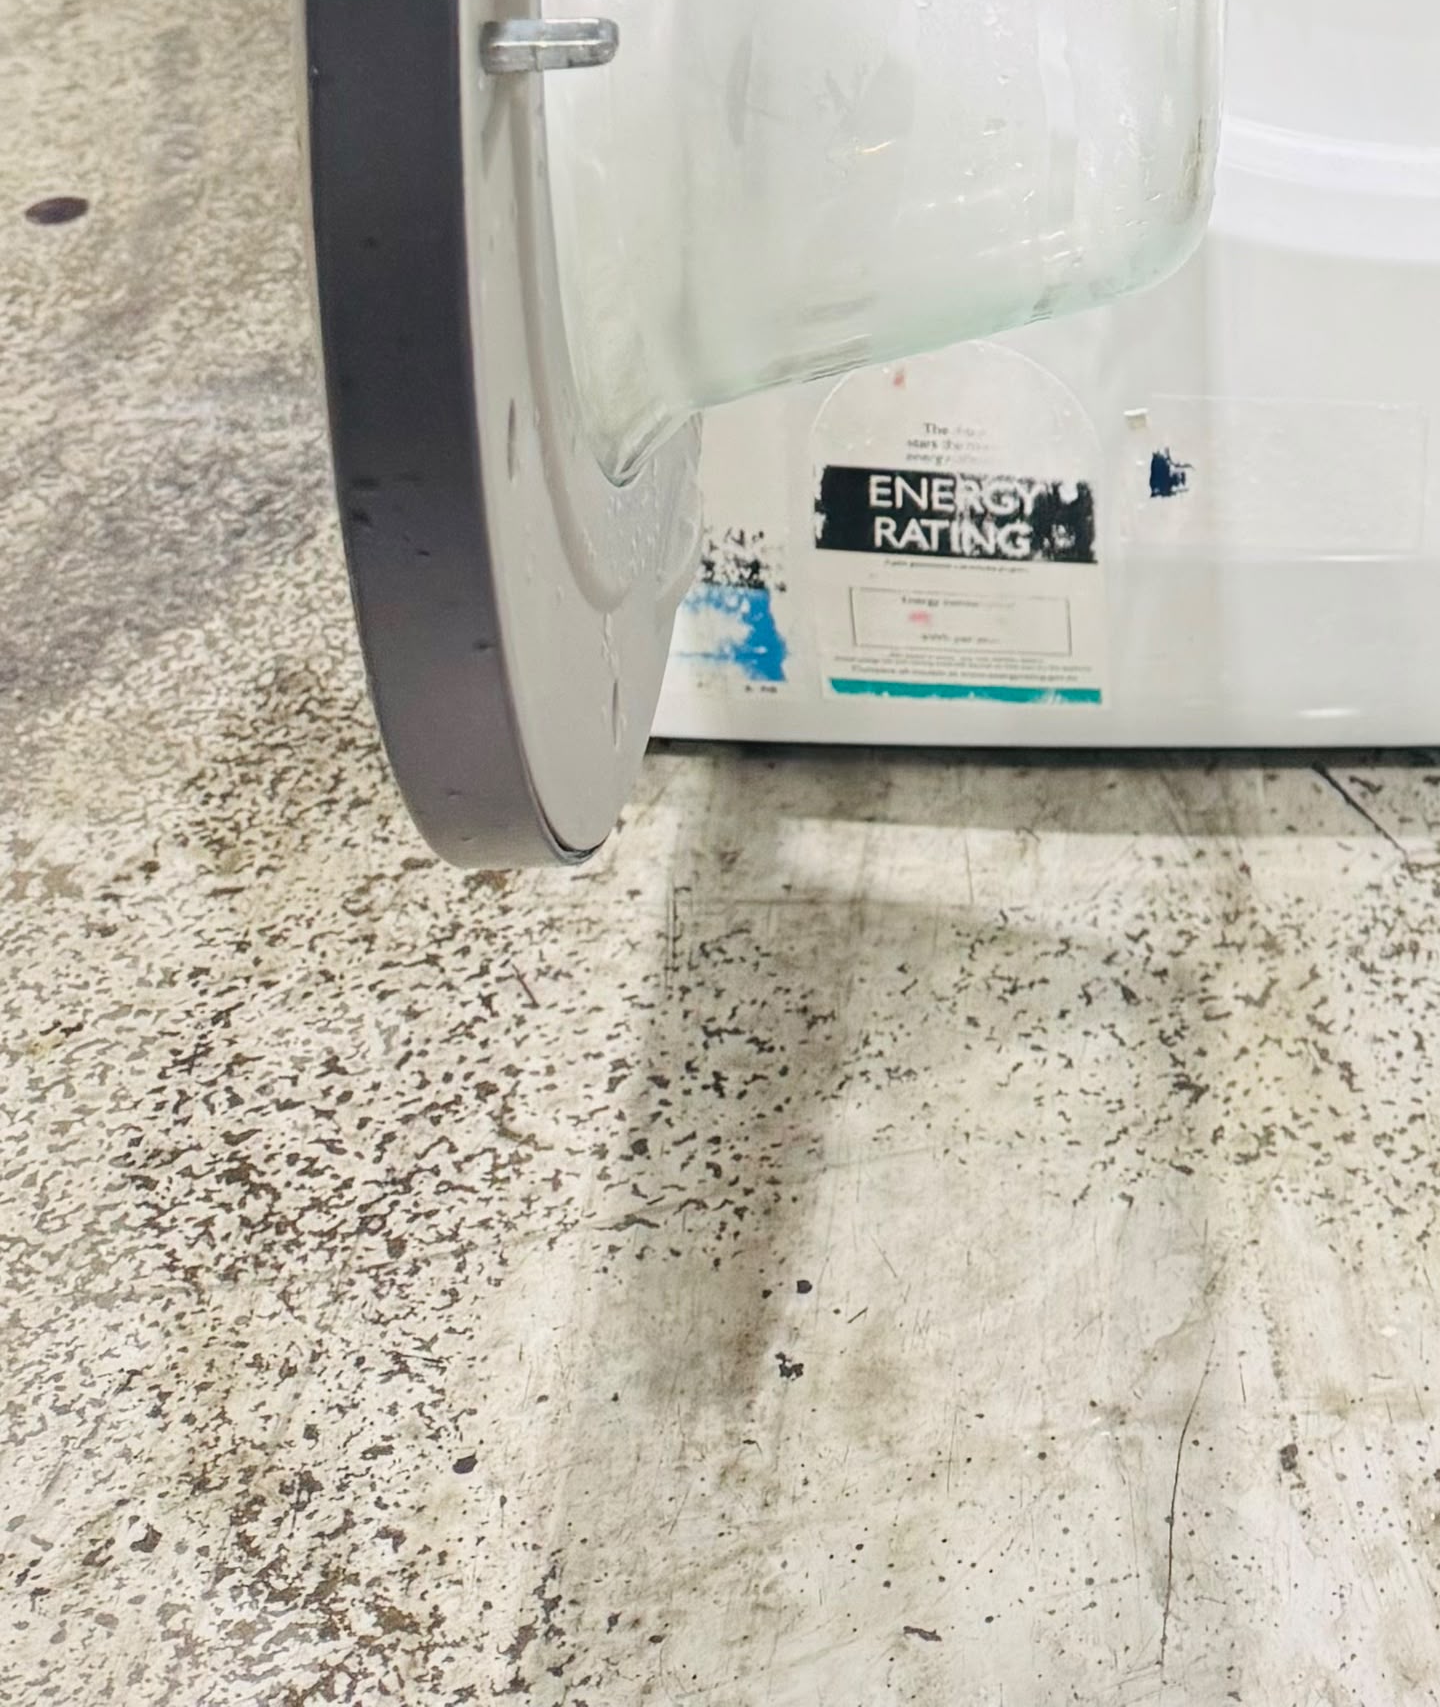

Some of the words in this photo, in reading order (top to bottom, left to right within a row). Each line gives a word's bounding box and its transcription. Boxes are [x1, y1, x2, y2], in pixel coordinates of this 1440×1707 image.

[924, 422, 949, 436] The
[869, 474, 1046, 517] ENERGY
[873, 515, 1033, 558] RATING
